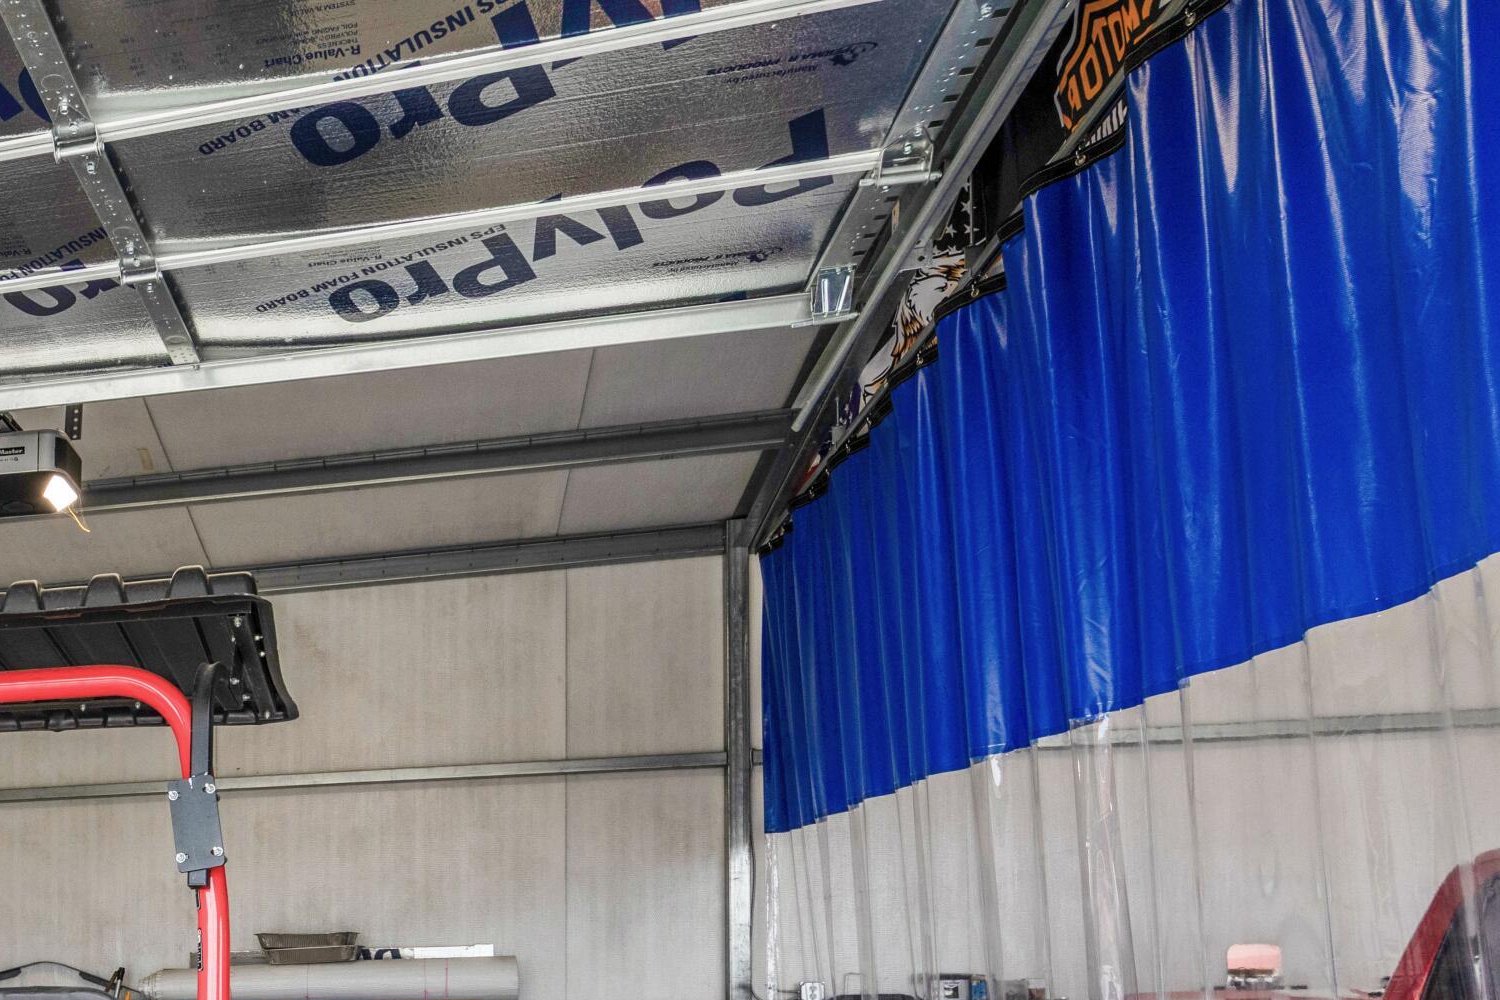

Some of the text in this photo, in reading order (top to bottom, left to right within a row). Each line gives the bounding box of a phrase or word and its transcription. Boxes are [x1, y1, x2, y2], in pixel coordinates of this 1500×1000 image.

[264, 45, 361, 69] R-Value Chart
[199, 120, 265, 155] BOARD
[469, 224, 507, 244] EPS
[360, 237, 468, 277] INSULATION
[3, 260, 122, 316] ro
[310, 271, 358, 294] FOAM
[255, 289, 309, 313] BOARD
